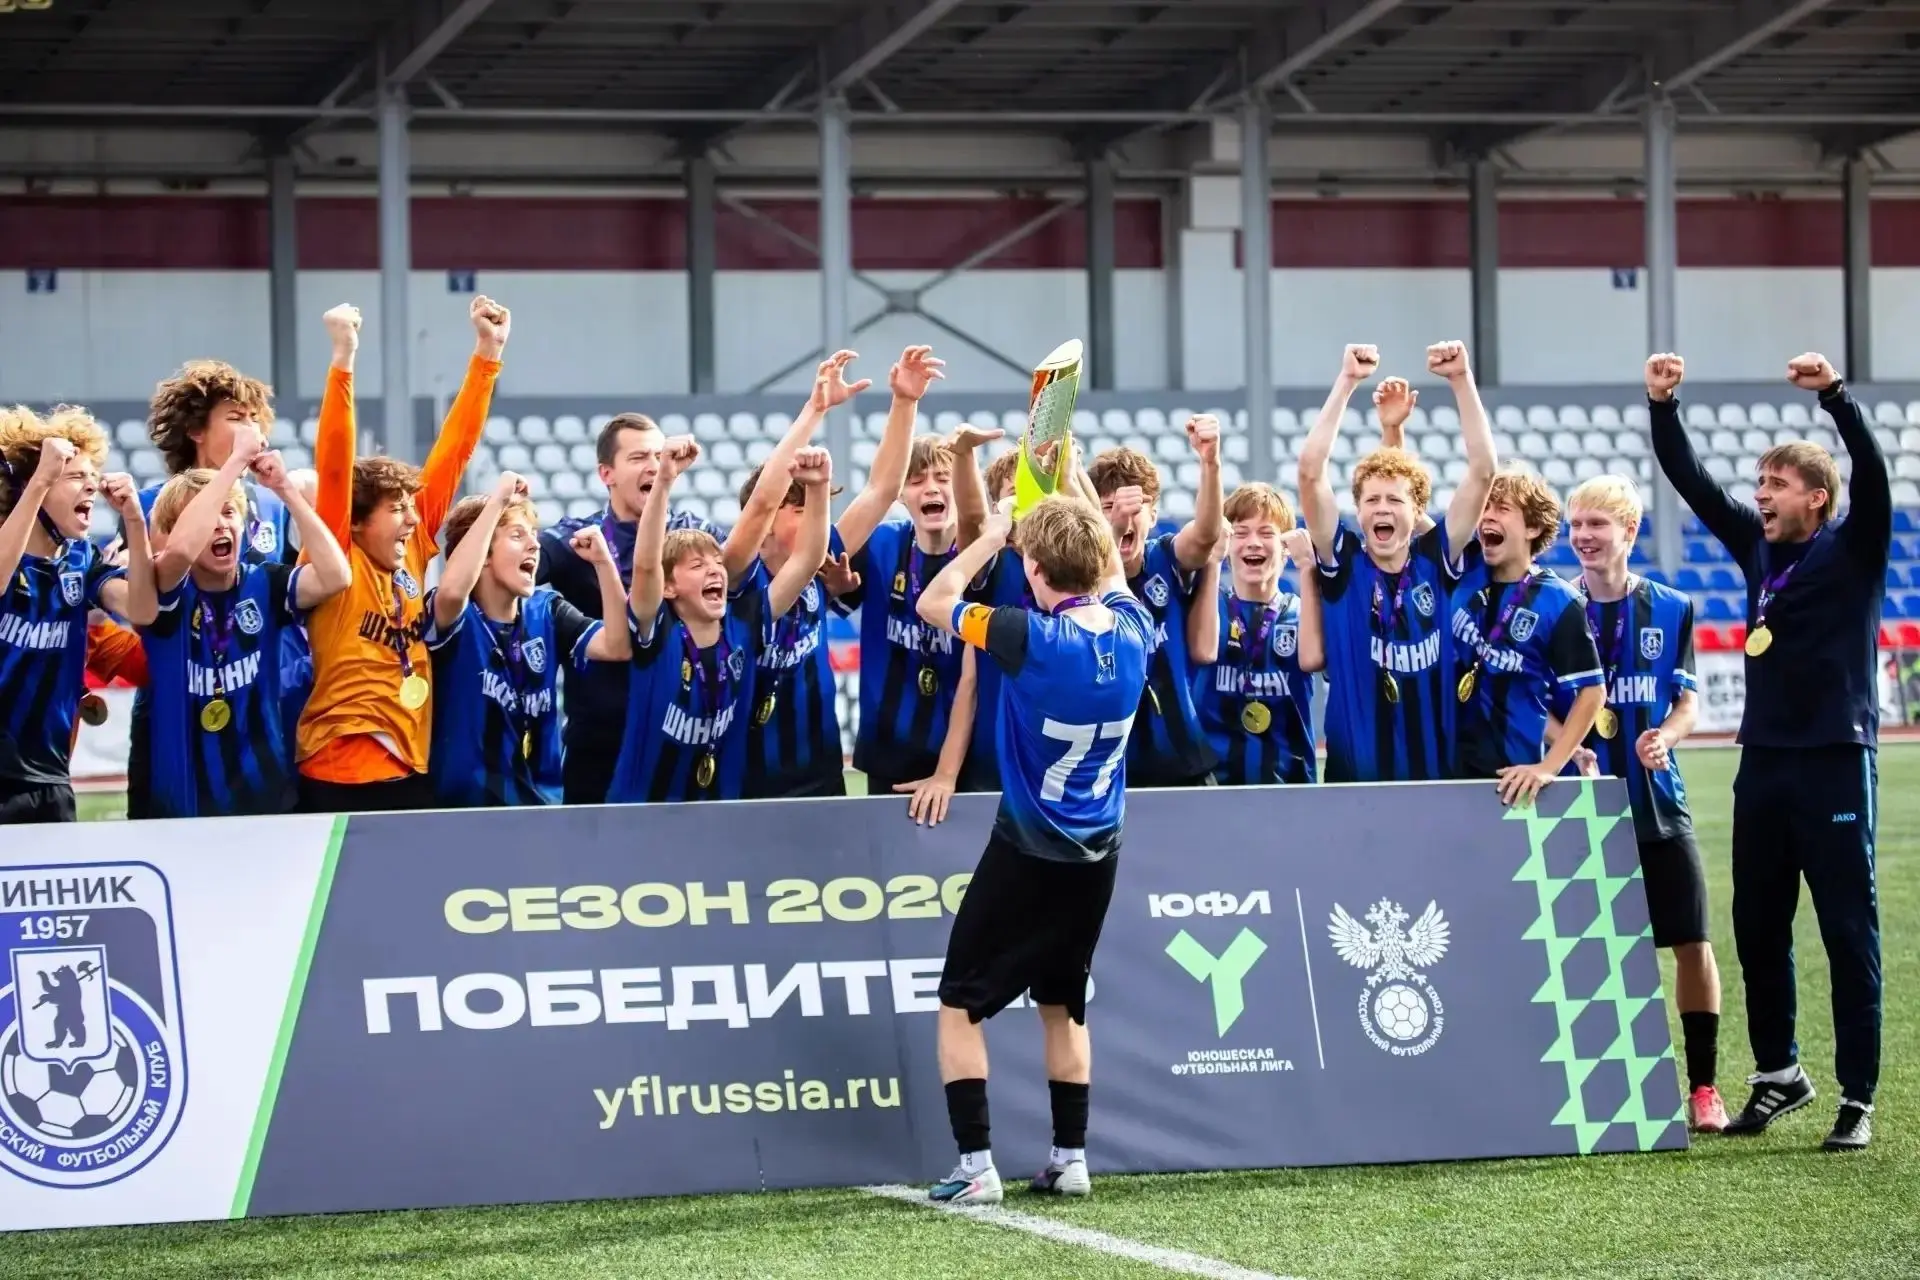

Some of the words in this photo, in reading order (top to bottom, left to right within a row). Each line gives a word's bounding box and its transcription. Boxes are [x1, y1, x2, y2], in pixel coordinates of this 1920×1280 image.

[1040, 714, 1134, 802] 77
[1832, 813, 1857, 822] JAKO
[19, 915, 90, 940] 1957
[443, 881, 750, 934] СЕЗОН
[1148, 890, 1272, 918] ЮФЛ
[362, 958, 1096, 1034] ПОБЕДИТЕ
[1358, 988, 1391, 1052] РОССИЙСКИЙ
[1391, 1016, 1445, 1057] ФУТБОЛЬНЫЙ
[1425, 984, 1444, 1015] СОЮЗ
[1171, 1061, 1258, 1075] ФУТБОЛЬНАЯ
[1260, 1060, 1294, 1072] ЛИГА
[1187, 1048, 1275, 1062] ЮНОШЕСКАЯ
[57, 1099, 162, 1167] ФУТБОЛЬНЫЙ
[144, 1040, 167, 1088] КЛУБ
[593, 1069, 900, 1130] yflrussia.ru
